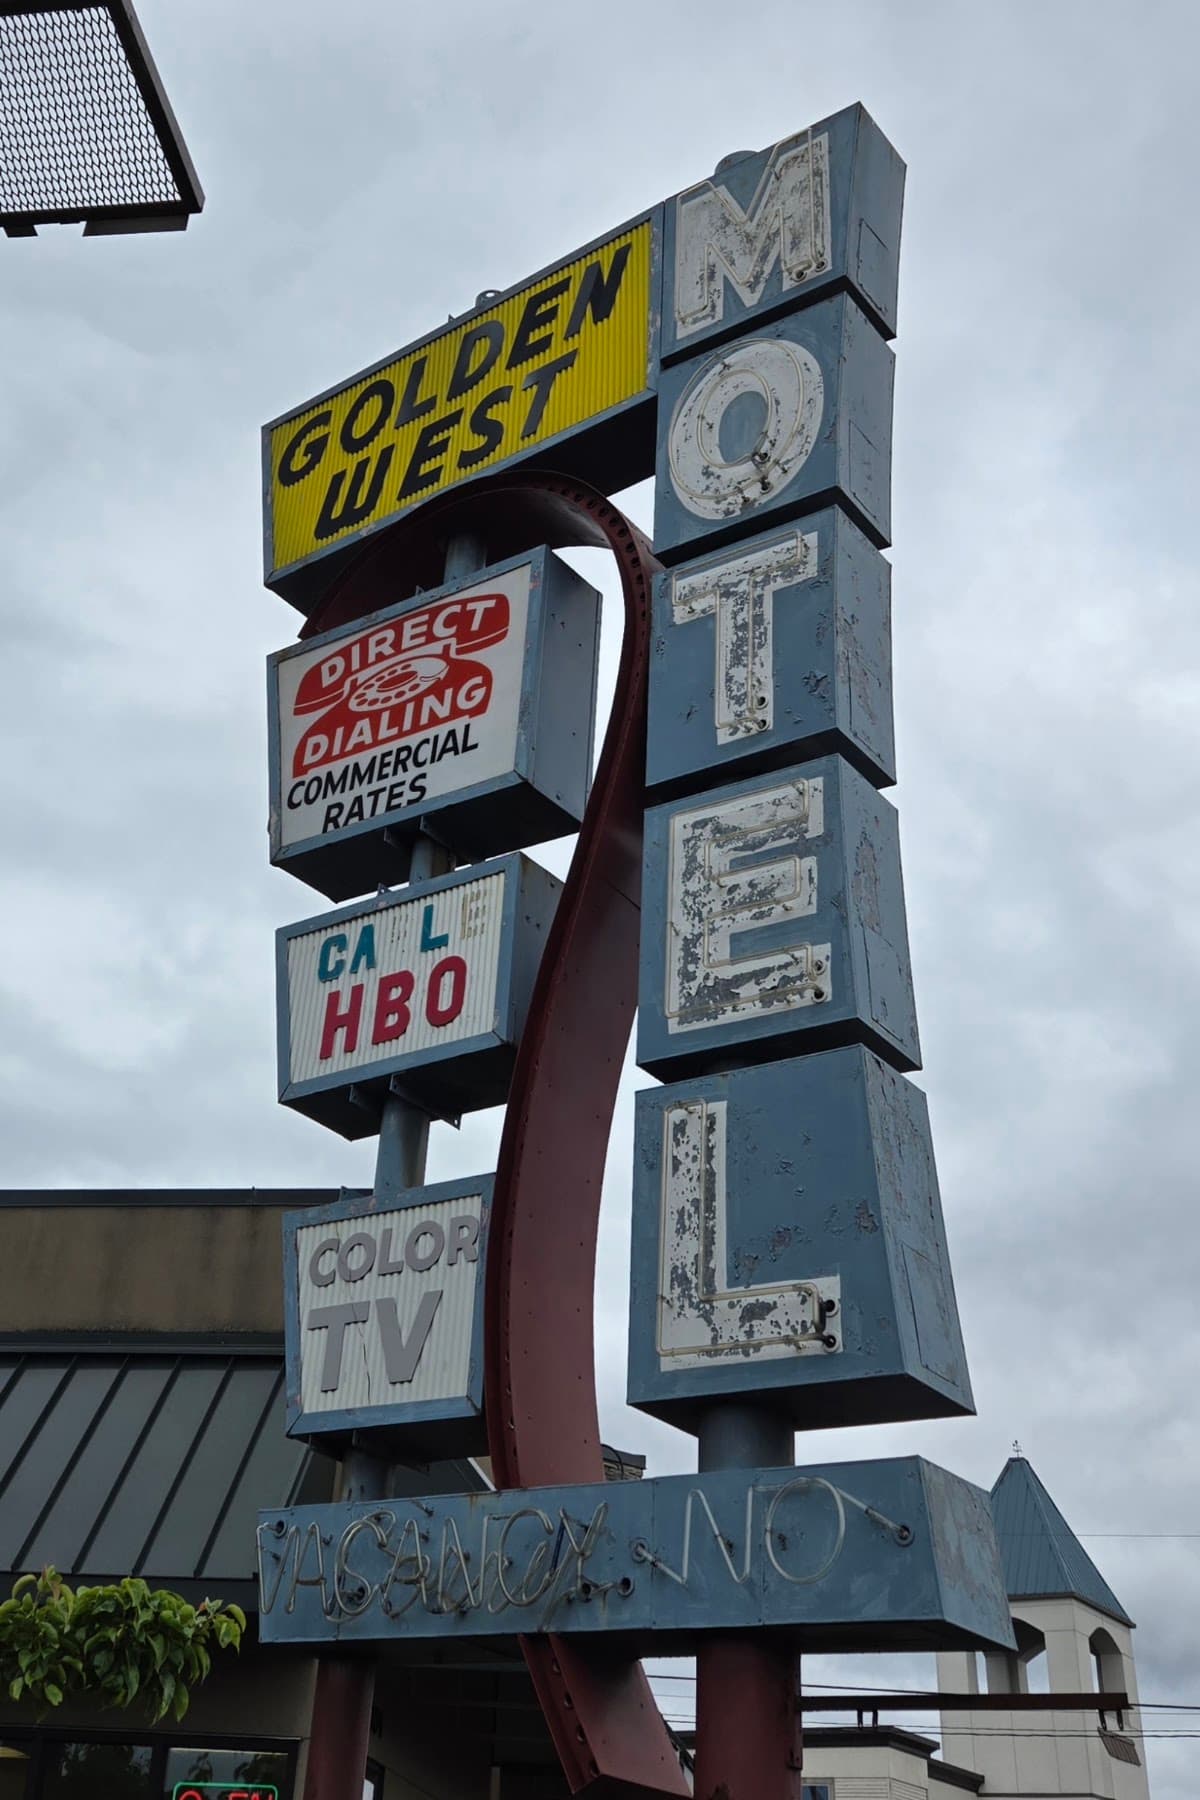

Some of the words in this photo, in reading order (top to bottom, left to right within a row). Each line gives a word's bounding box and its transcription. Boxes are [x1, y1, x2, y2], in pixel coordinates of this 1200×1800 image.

[277, 242, 632, 488] GOLDEN
[313, 348, 579, 542] WEST
[320, 599, 498, 689] DIRECT
[286, 722, 480, 811] COMMERCIAL
[301, 675, 487, 767] DIALING
[655, 126, 844, 1373] MOTEL
[321, 772, 428, 835] RATES
[319, 955, 468, 1061] HBO
[308, 1214, 480, 1289] COLOR
[307, 1289, 444, 1394] TV
[255, 1502, 609, 1617] VACANCY
[680, 1476, 847, 1585] NO
